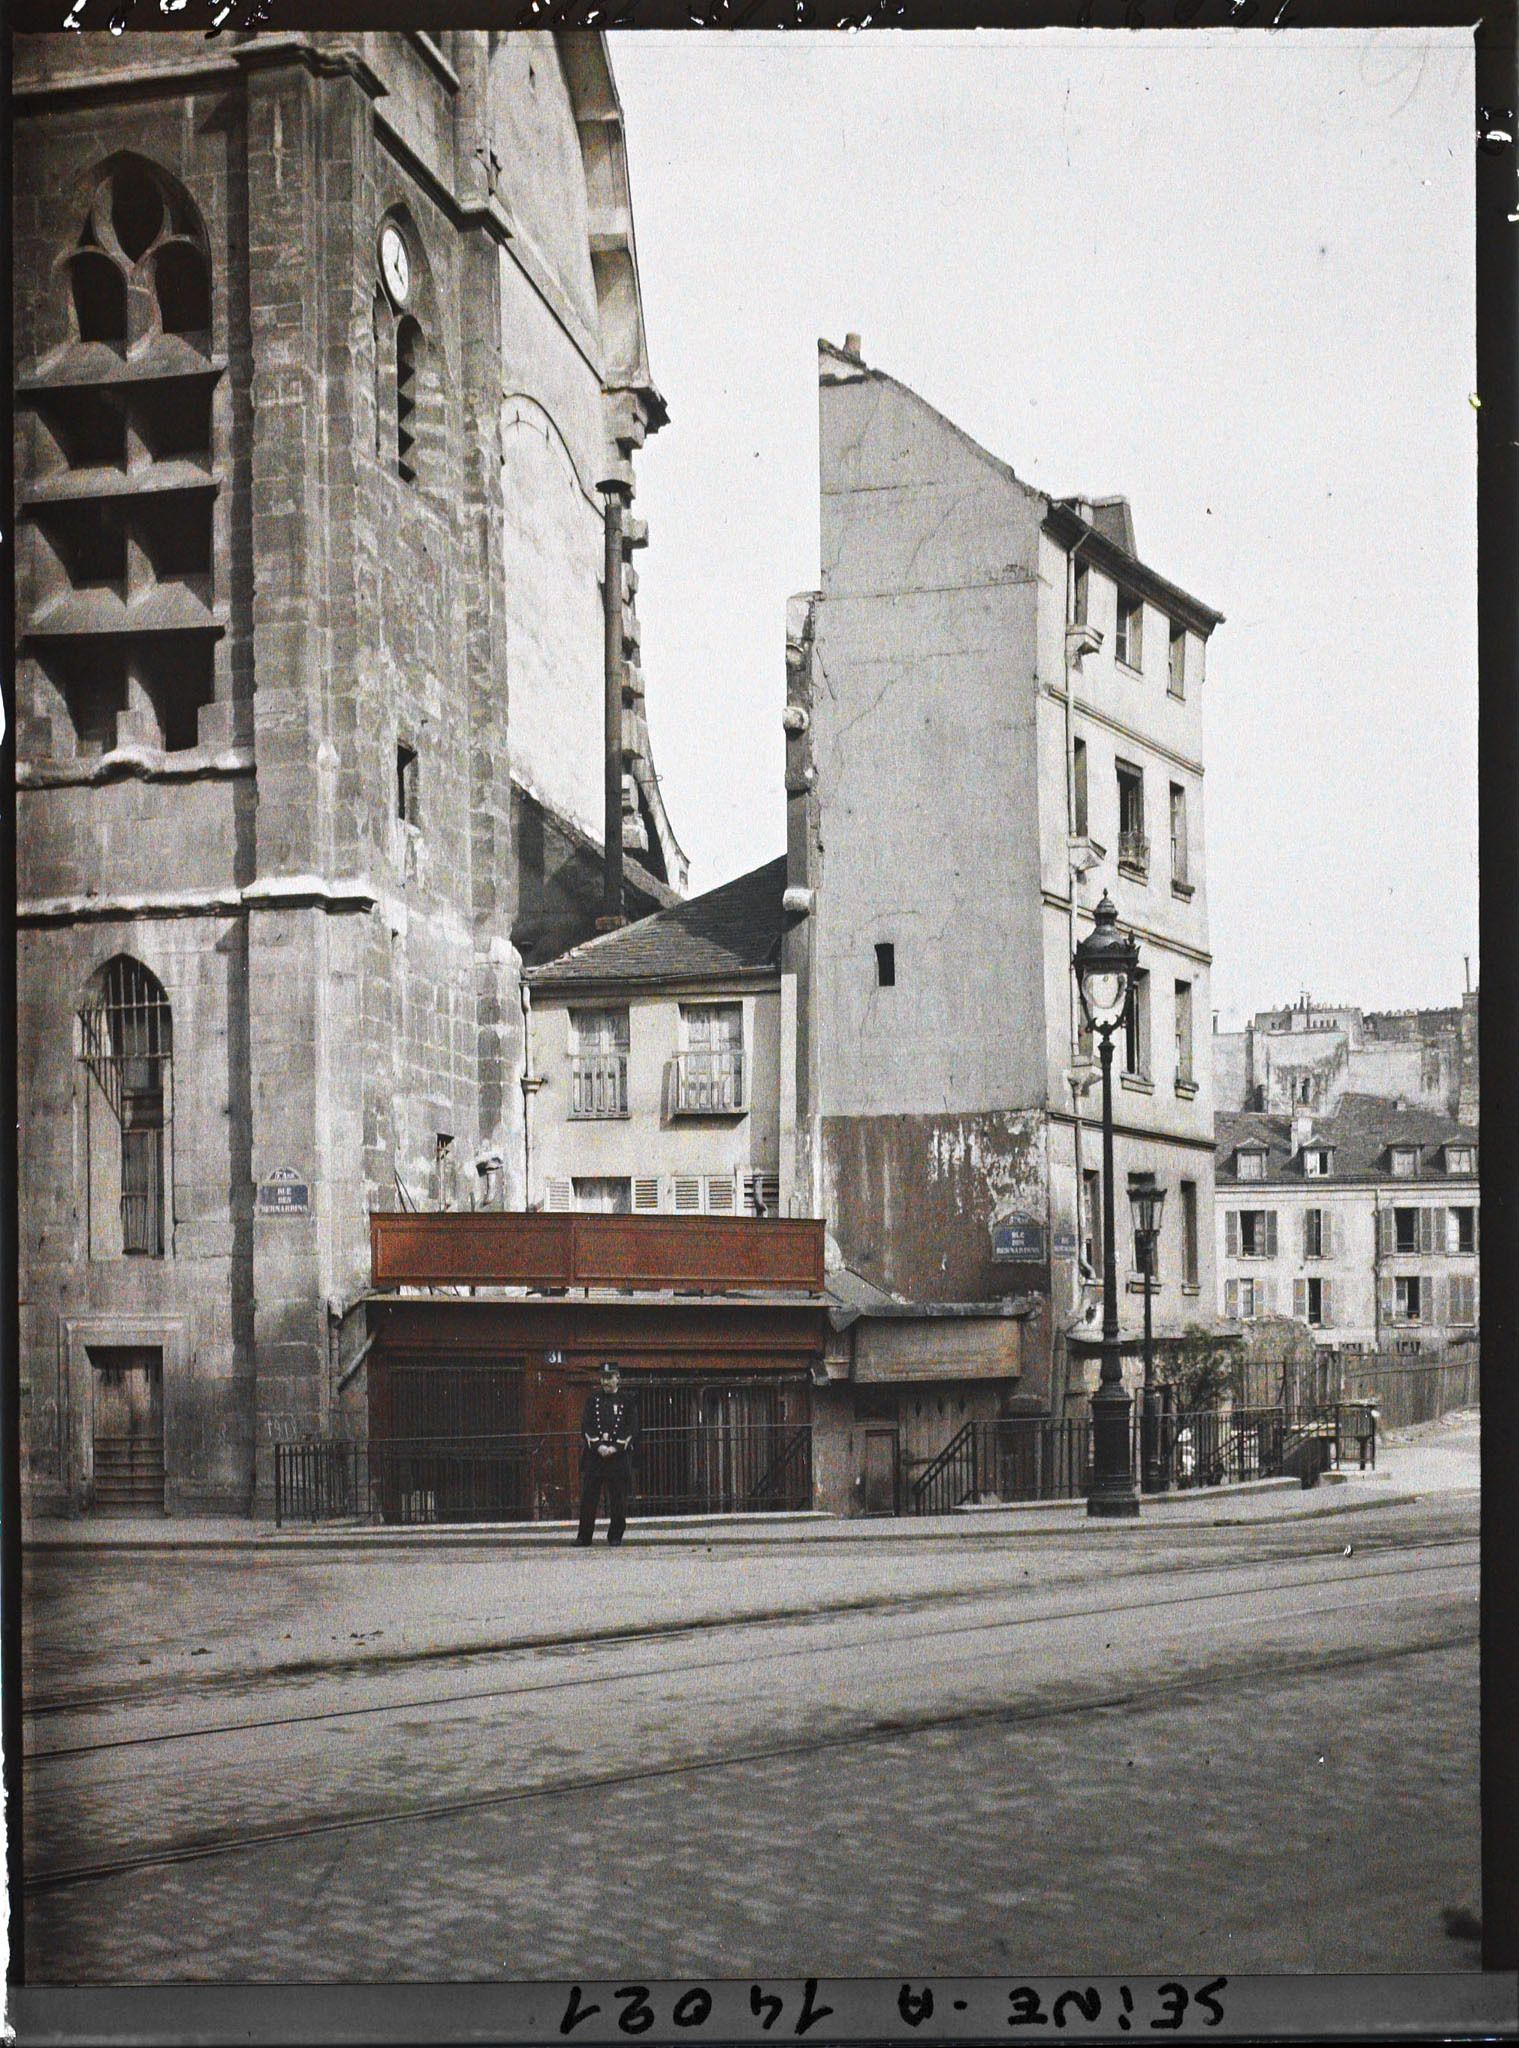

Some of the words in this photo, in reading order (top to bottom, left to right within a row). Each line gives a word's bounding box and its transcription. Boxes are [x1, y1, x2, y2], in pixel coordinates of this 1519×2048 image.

[277, 1187, 292, 1195] RUE
[260, 1205, 308, 1213] BERNARDINS
[1011, 1231, 1025, 1239] RUE
[548, 1351, 562, 1363] 31
[559, 1985, 713, 2034] 021
[750, 1978, 834, 2035] 14
[898, 1984, 934, 2027] A
